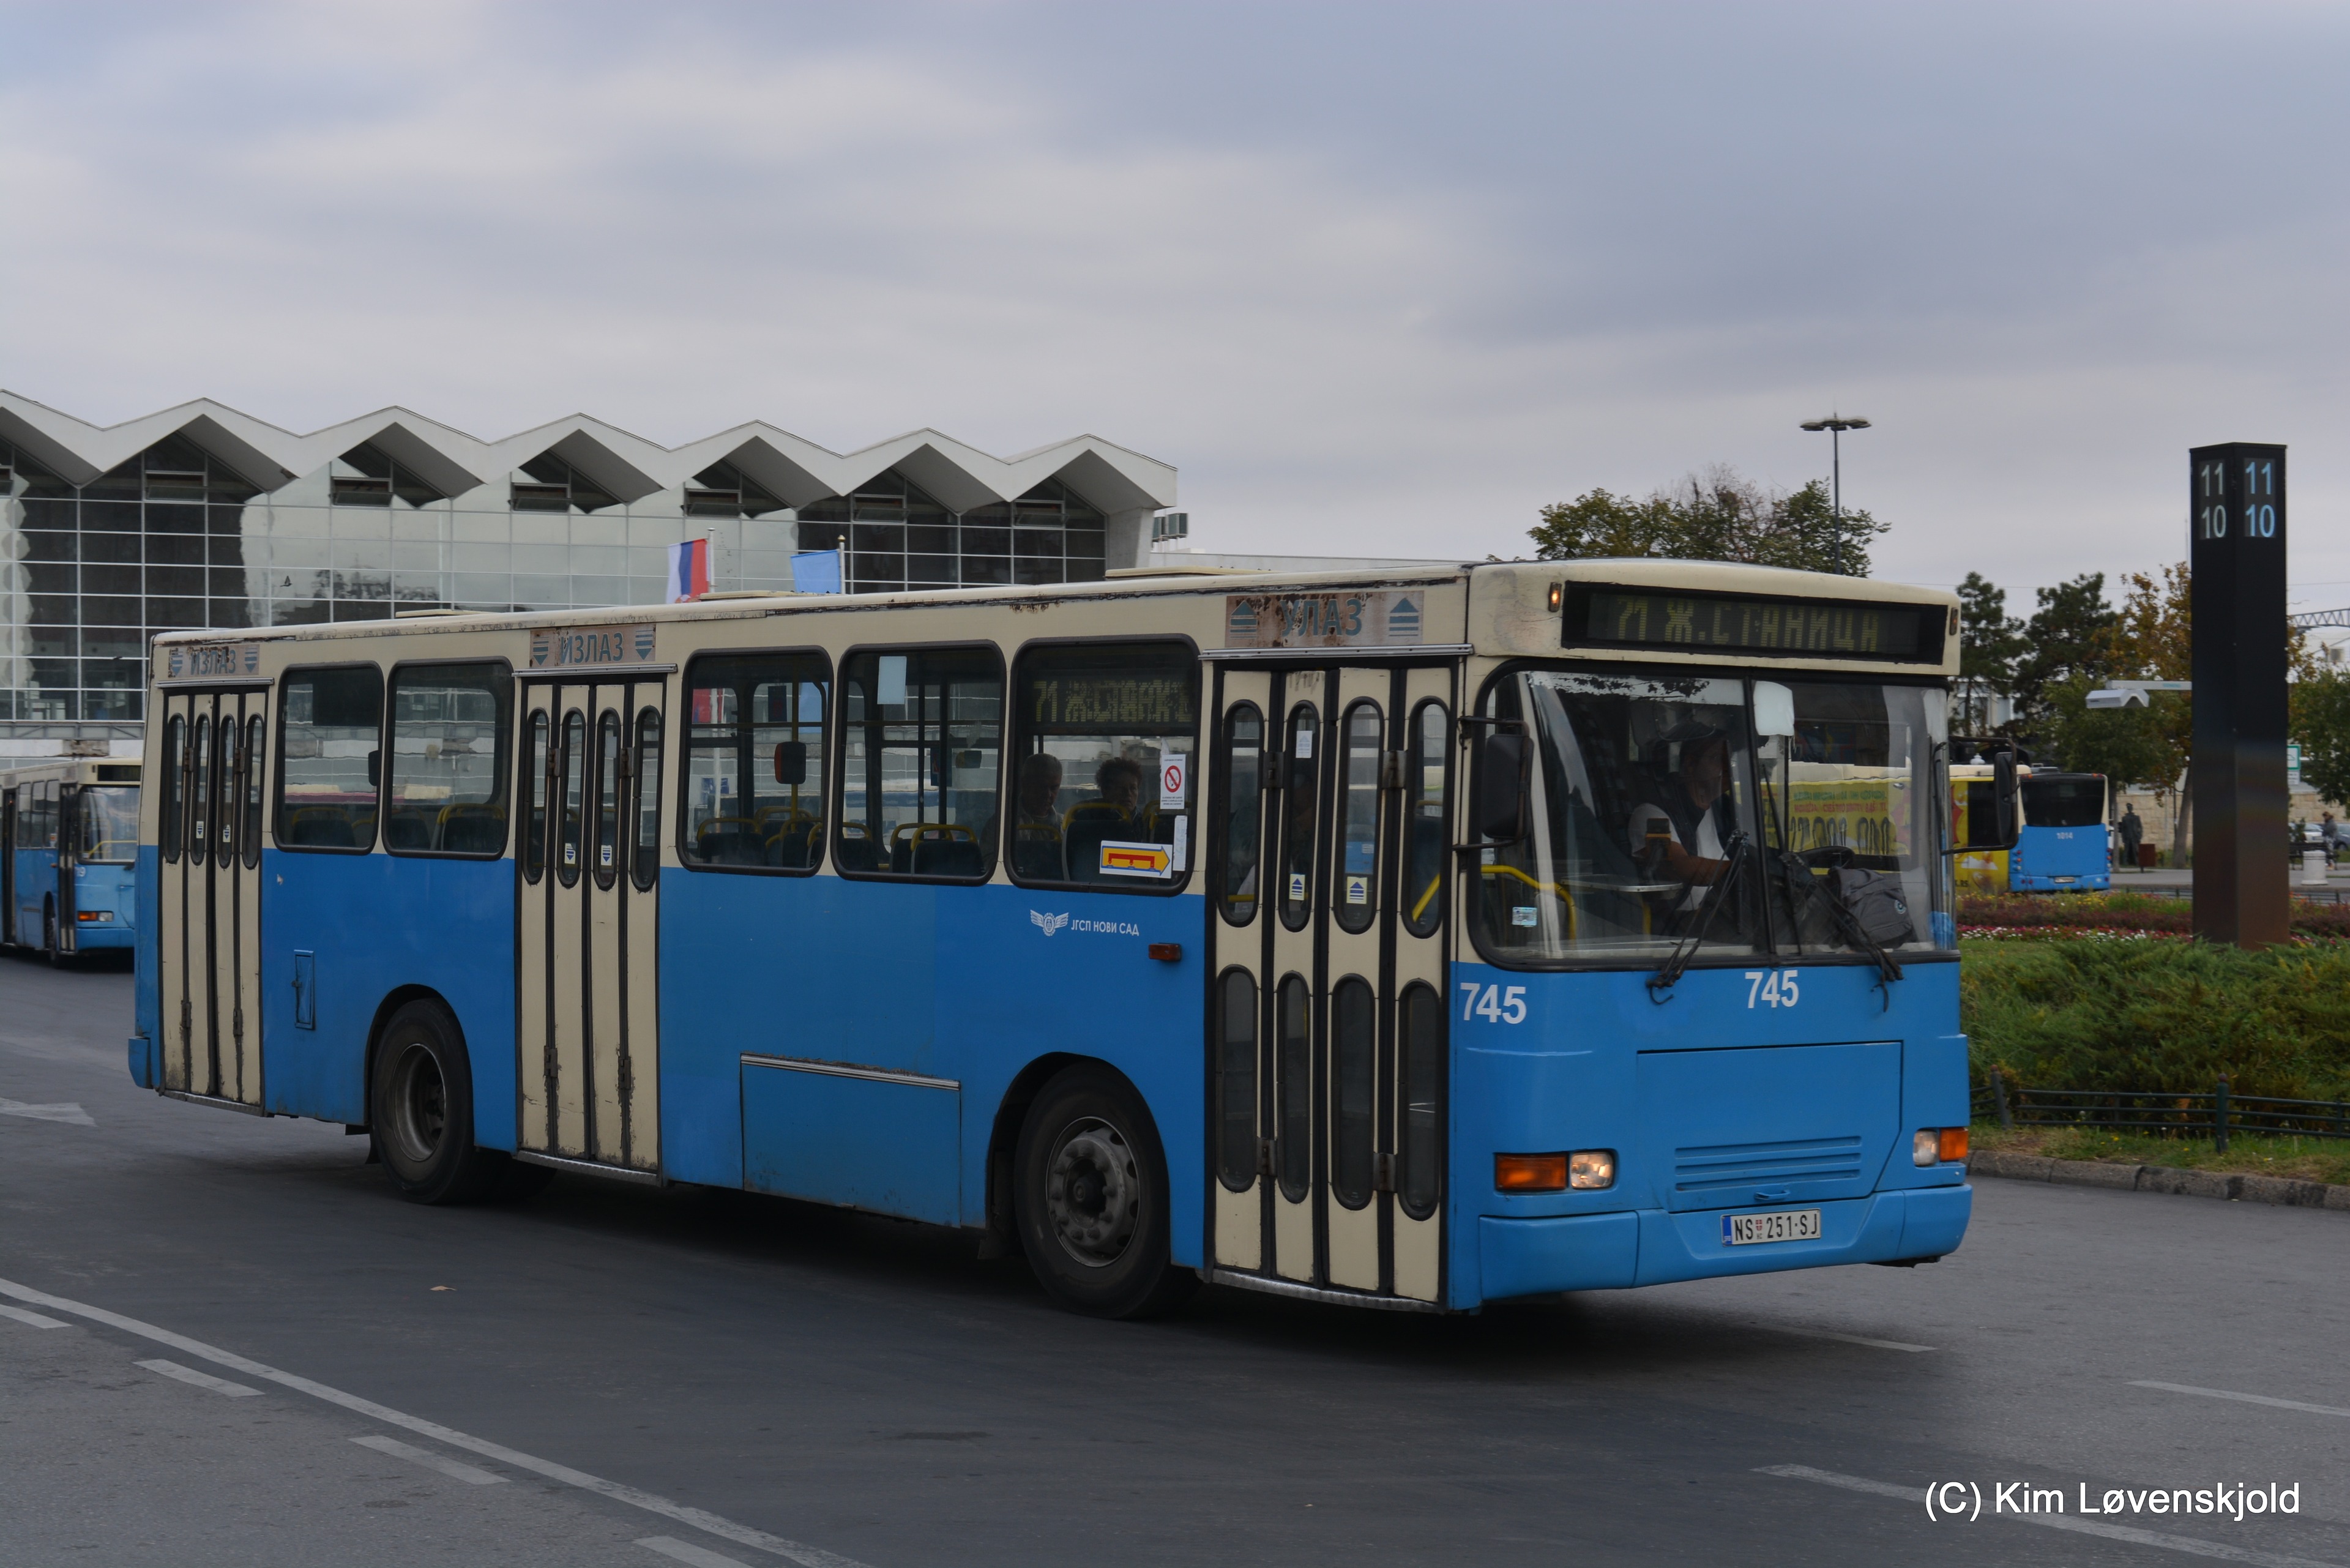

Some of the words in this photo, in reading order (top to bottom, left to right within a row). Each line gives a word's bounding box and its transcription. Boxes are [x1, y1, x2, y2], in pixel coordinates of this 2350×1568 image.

[2201, 463, 2223, 496] 11
[2245, 461, 2271, 495] 11
[2201, 505, 2226, 539] 10
[2245, 504, 2275, 537] 10
[1280, 598, 1362, 637] УЛАЗ
[1617, 599, 1648, 640] 71
[190, 649, 236, 675] ИЗЛАЗ
[561, 632, 624, 664] ИЗЛАЗ
[1034, 681, 1058, 722] 71
[1071, 919, 1091, 931] ЈГСП
[1094, 921, 1117, 933] НОВИ
[1119, 923, 1140, 936] САД
[1460, 982, 1527, 1024] 745
[1745, 969, 1799, 1009] 745
[1734, 1219, 1753, 1241] NS
